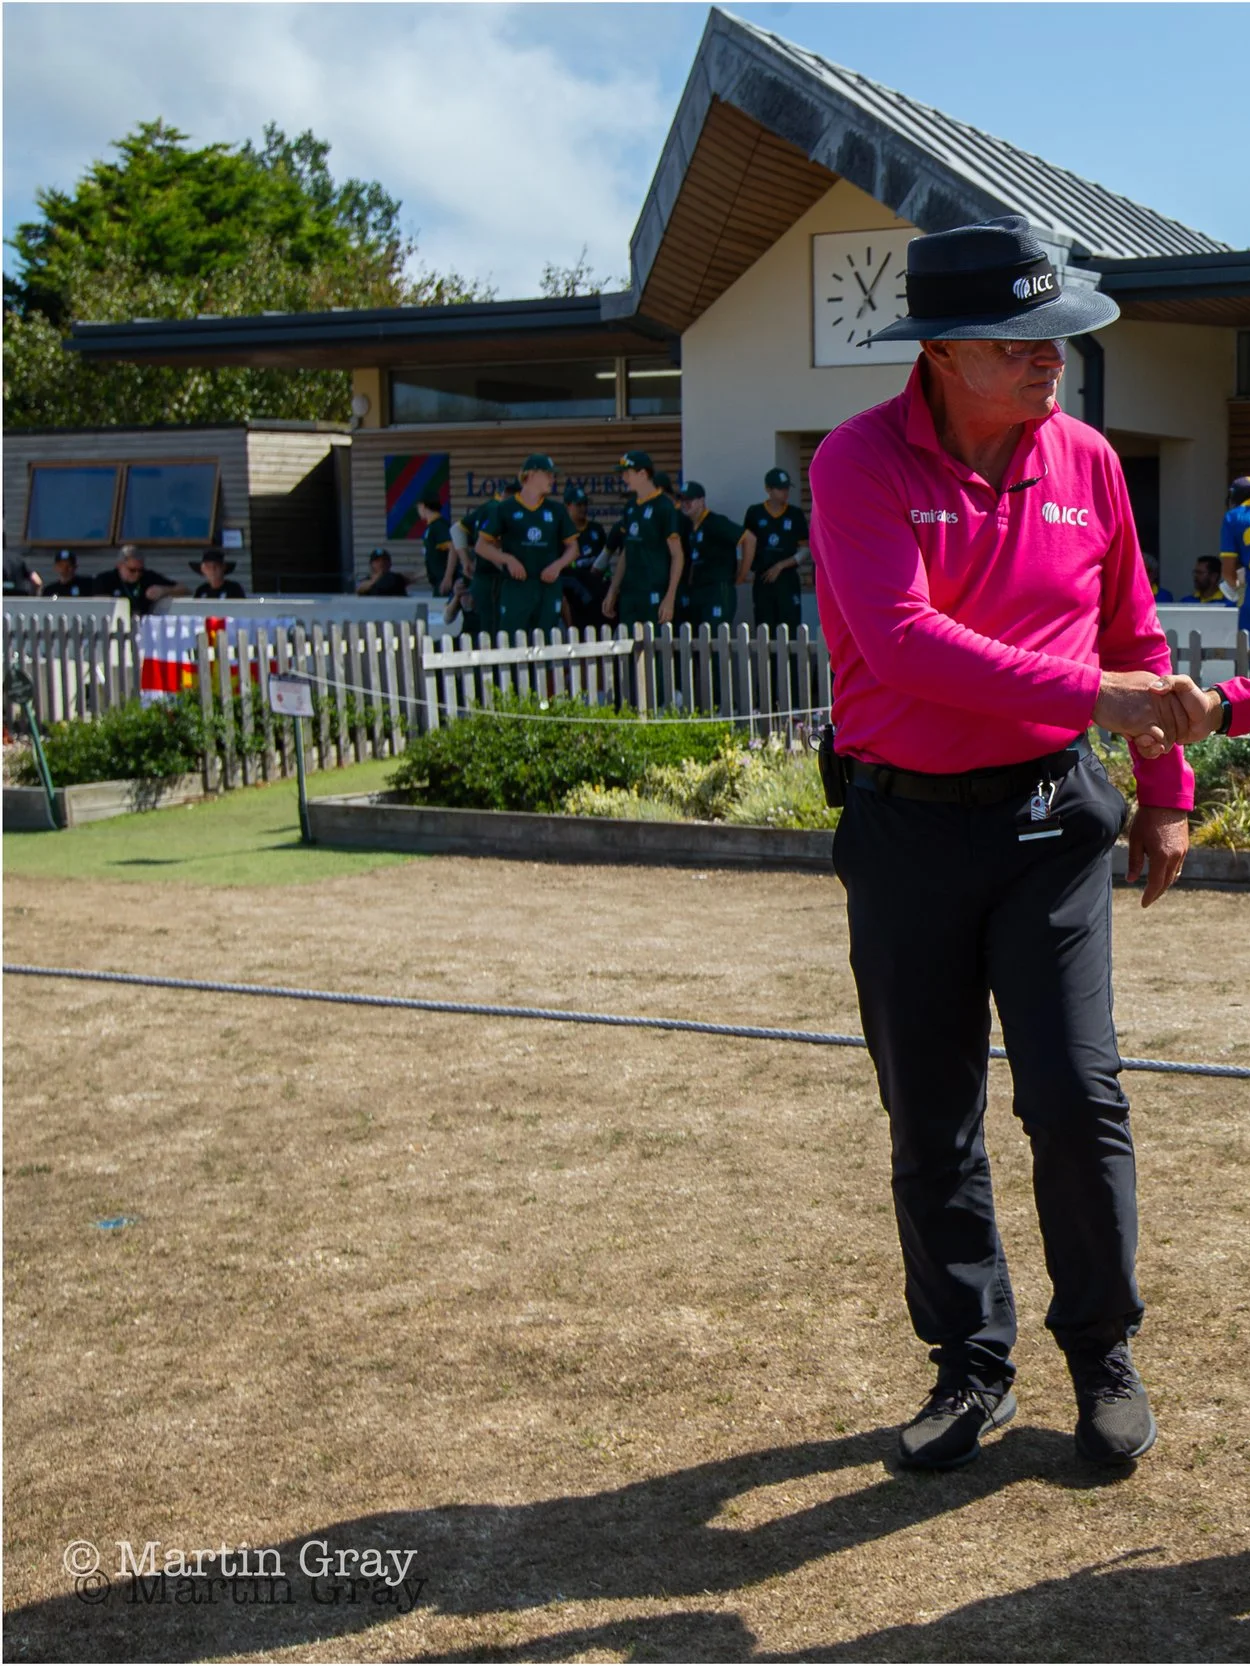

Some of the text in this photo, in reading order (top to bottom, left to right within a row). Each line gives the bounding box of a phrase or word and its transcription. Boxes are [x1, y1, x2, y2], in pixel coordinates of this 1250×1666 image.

[1032, 273, 1053, 295] ICC
[910, 509, 959, 525] Emirates
[1061, 507, 1089, 527] ICC
